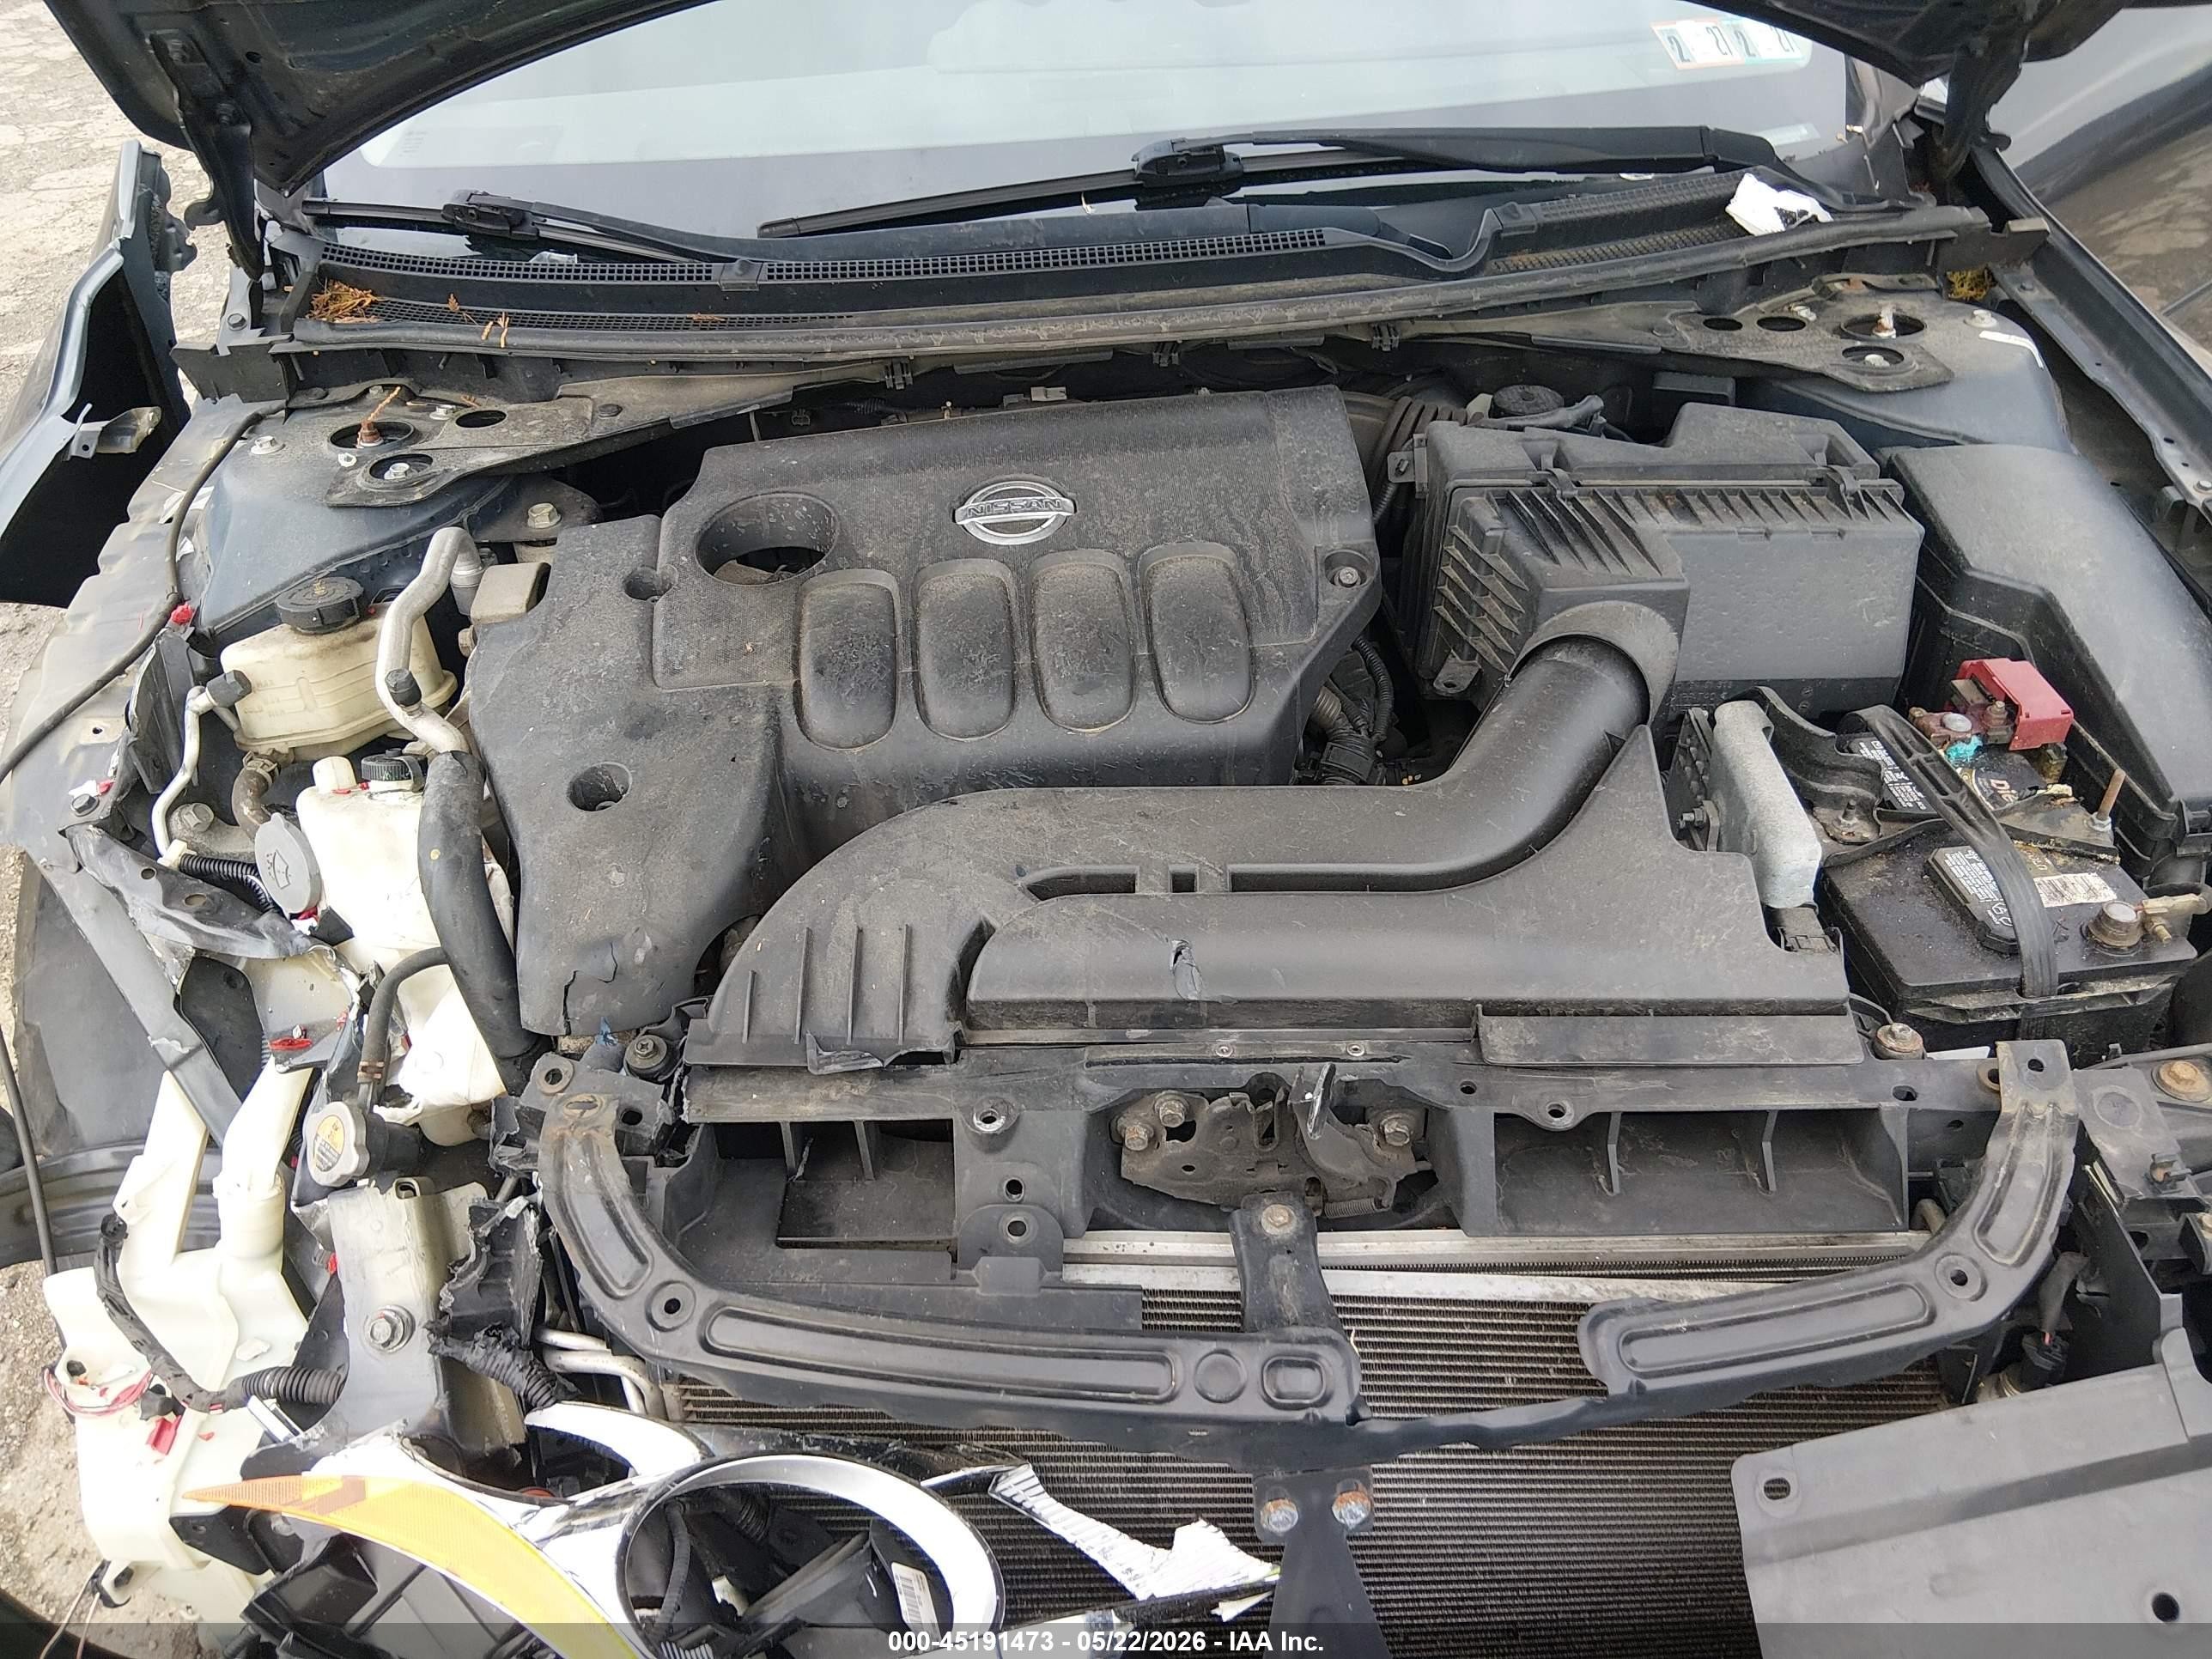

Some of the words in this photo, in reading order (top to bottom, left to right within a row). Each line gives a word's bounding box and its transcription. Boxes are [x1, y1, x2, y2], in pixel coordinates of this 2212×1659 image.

[1667, 34, 1691, 63] 2
[1705, 26, 1733, 56] 27
[1734, 30, 1757, 58] 2
[967, 499, 1064, 517] NISSAN
